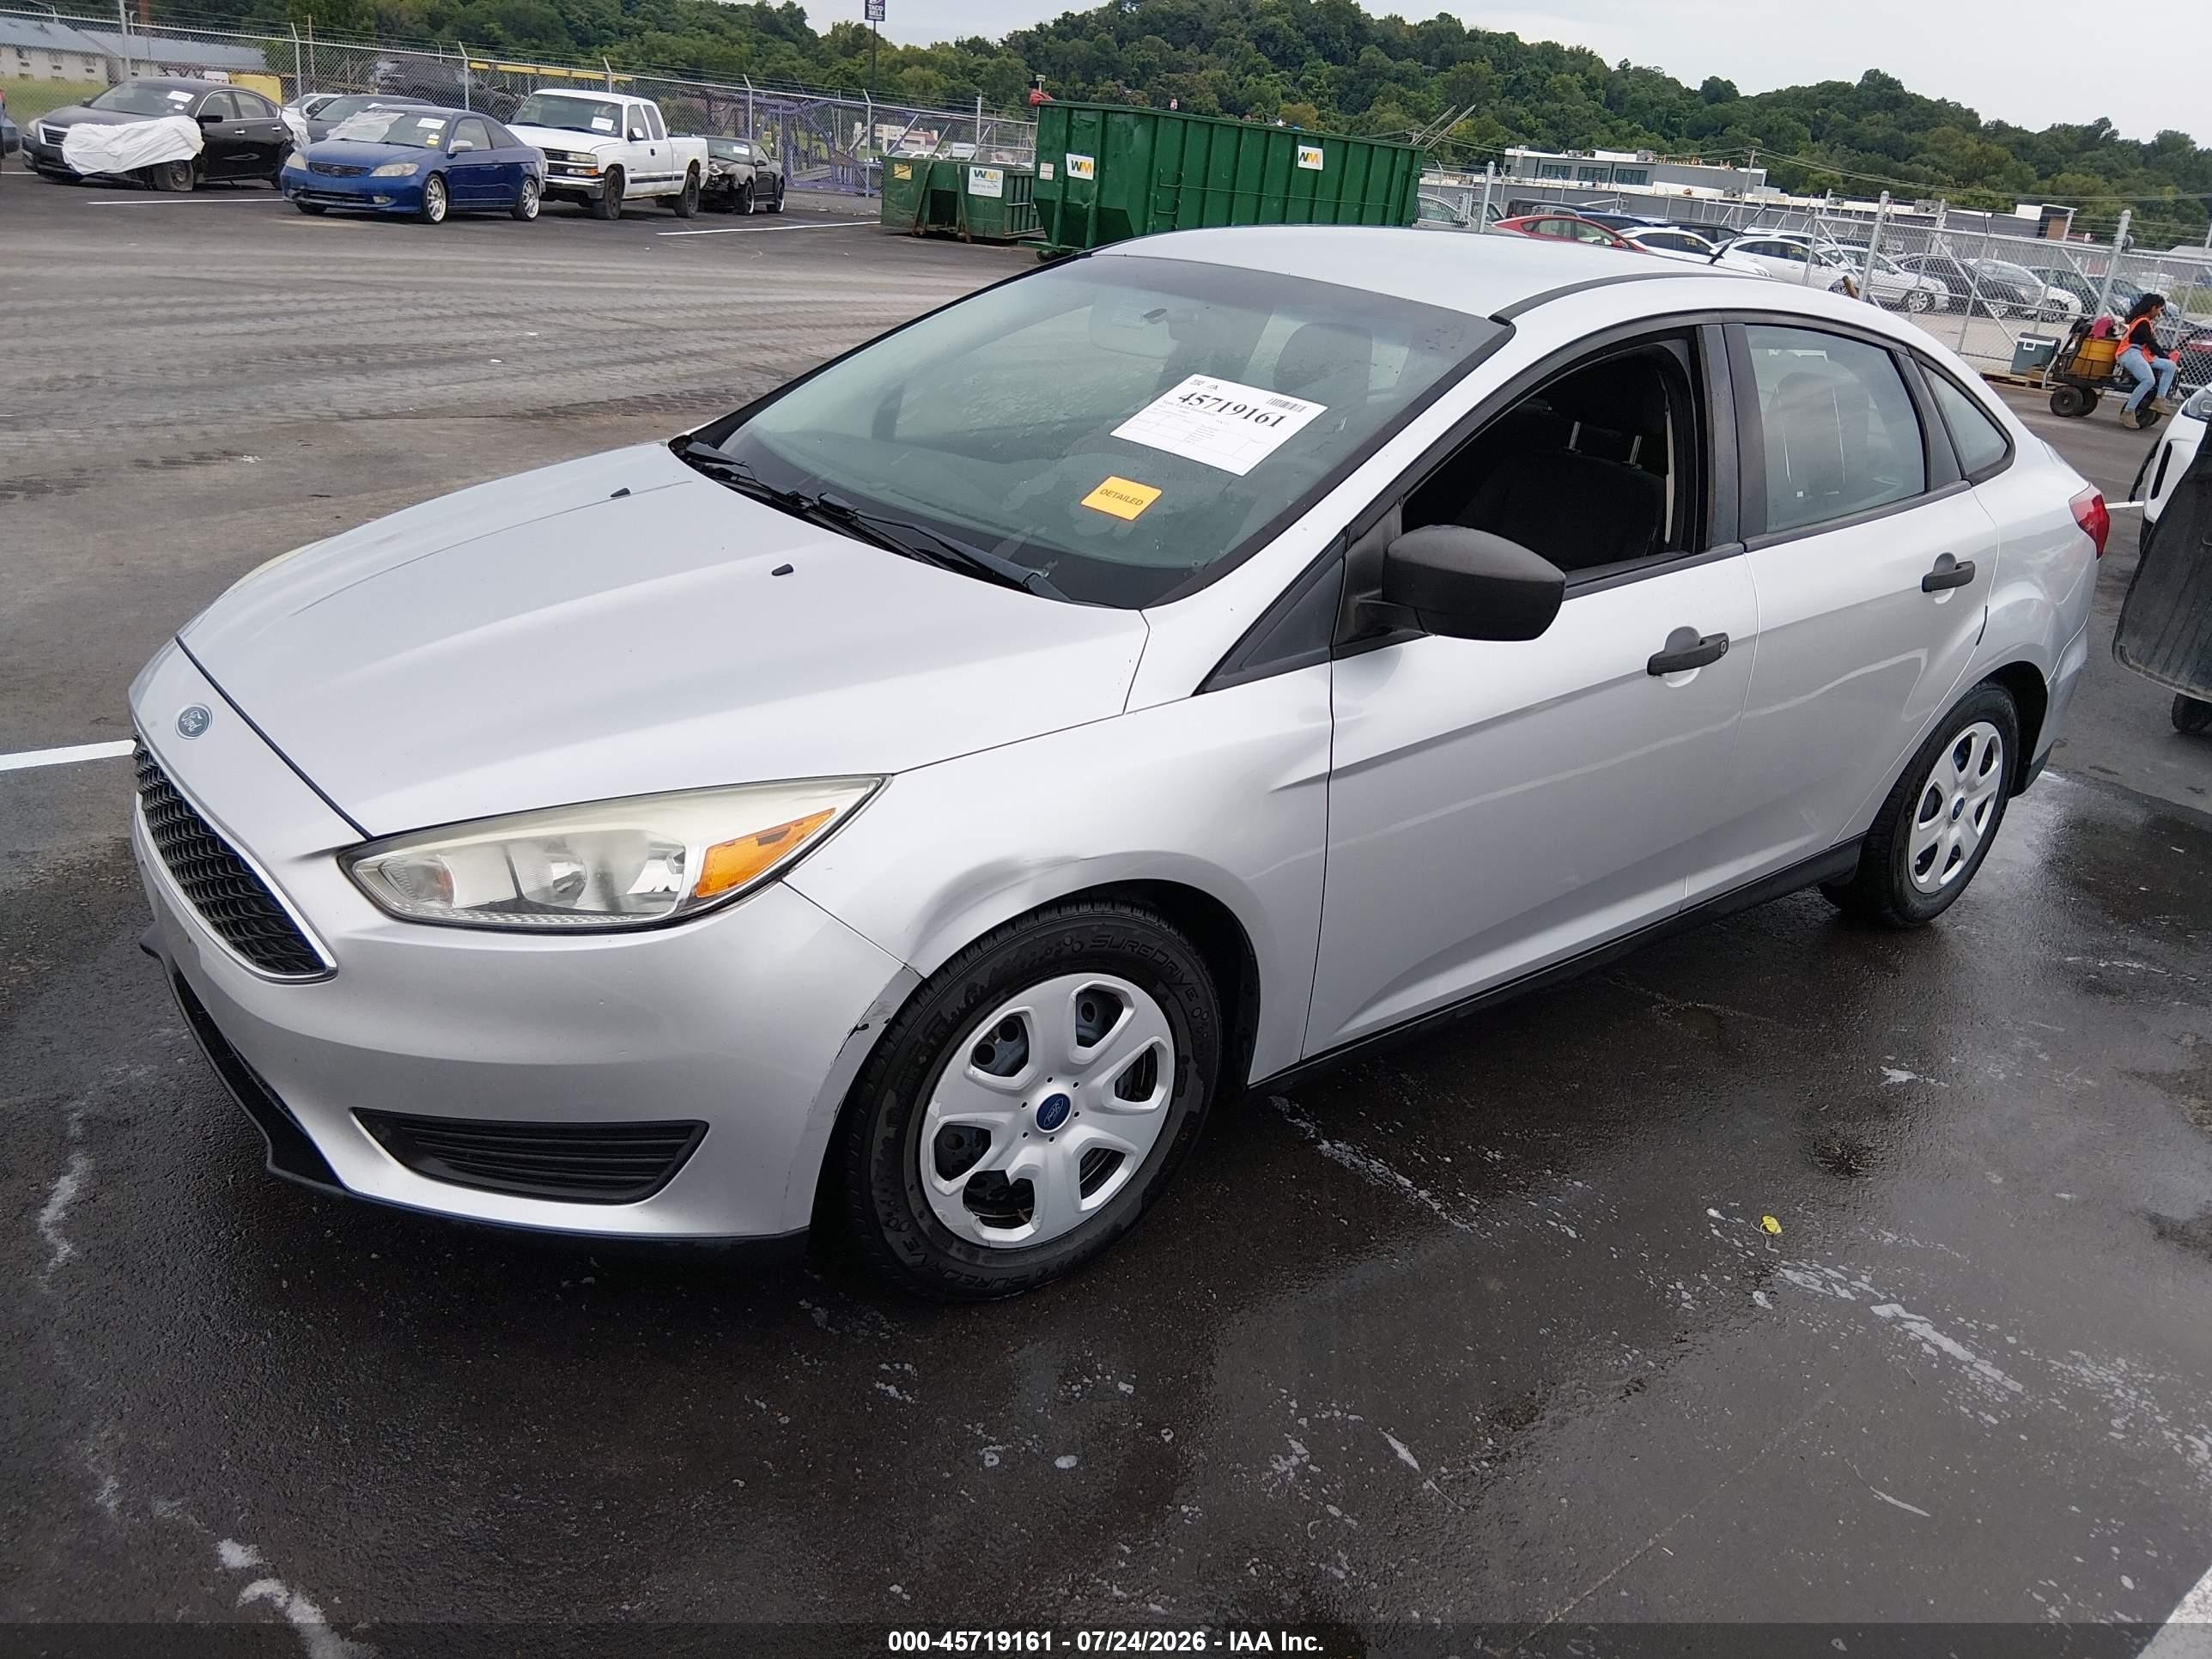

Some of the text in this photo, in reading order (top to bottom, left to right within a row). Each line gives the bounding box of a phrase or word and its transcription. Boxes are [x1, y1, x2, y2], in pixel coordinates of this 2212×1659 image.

[974, 169, 999, 179] WM
[1071, 160, 1092, 173] WM
[1178, 392, 1287, 428] 45719161
[1099, 489, 1144, 506] DETAILED
